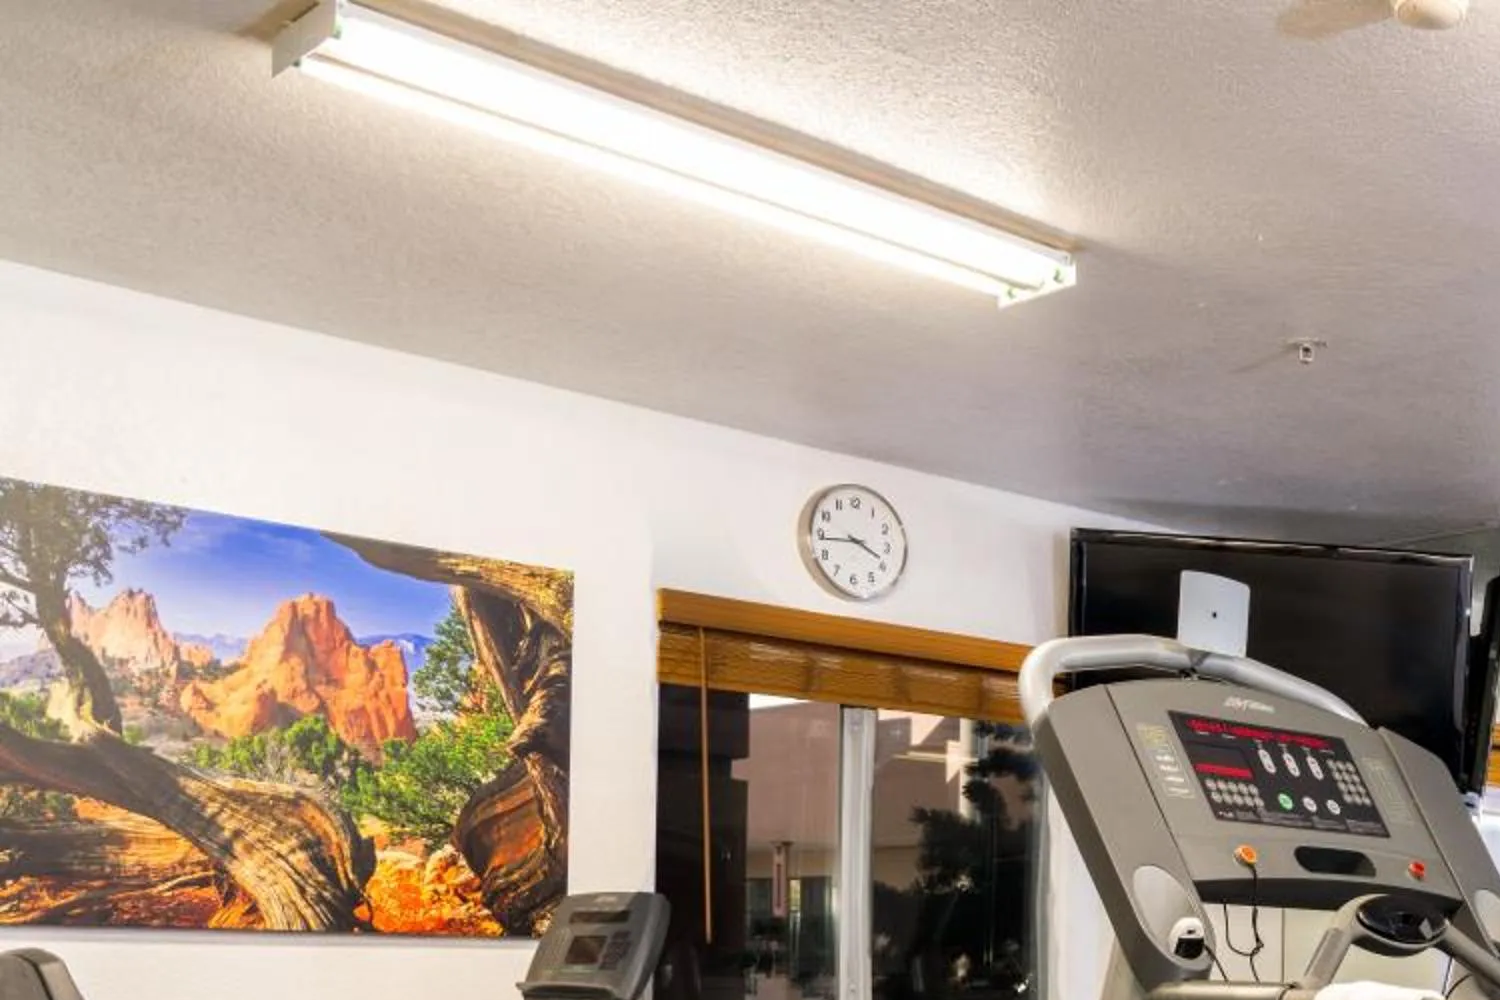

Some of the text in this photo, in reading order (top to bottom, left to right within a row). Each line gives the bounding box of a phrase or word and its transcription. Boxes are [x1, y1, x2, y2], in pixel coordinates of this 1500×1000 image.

[821, 509, 831, 522] 10
[816, 527, 825, 541] 9
[881, 522, 889, 535] 2
[883, 541, 891, 554] 3
[833, 564, 841, 577] 7
[867, 571, 876, 583] 5
[849, 573, 858, 585] 6
